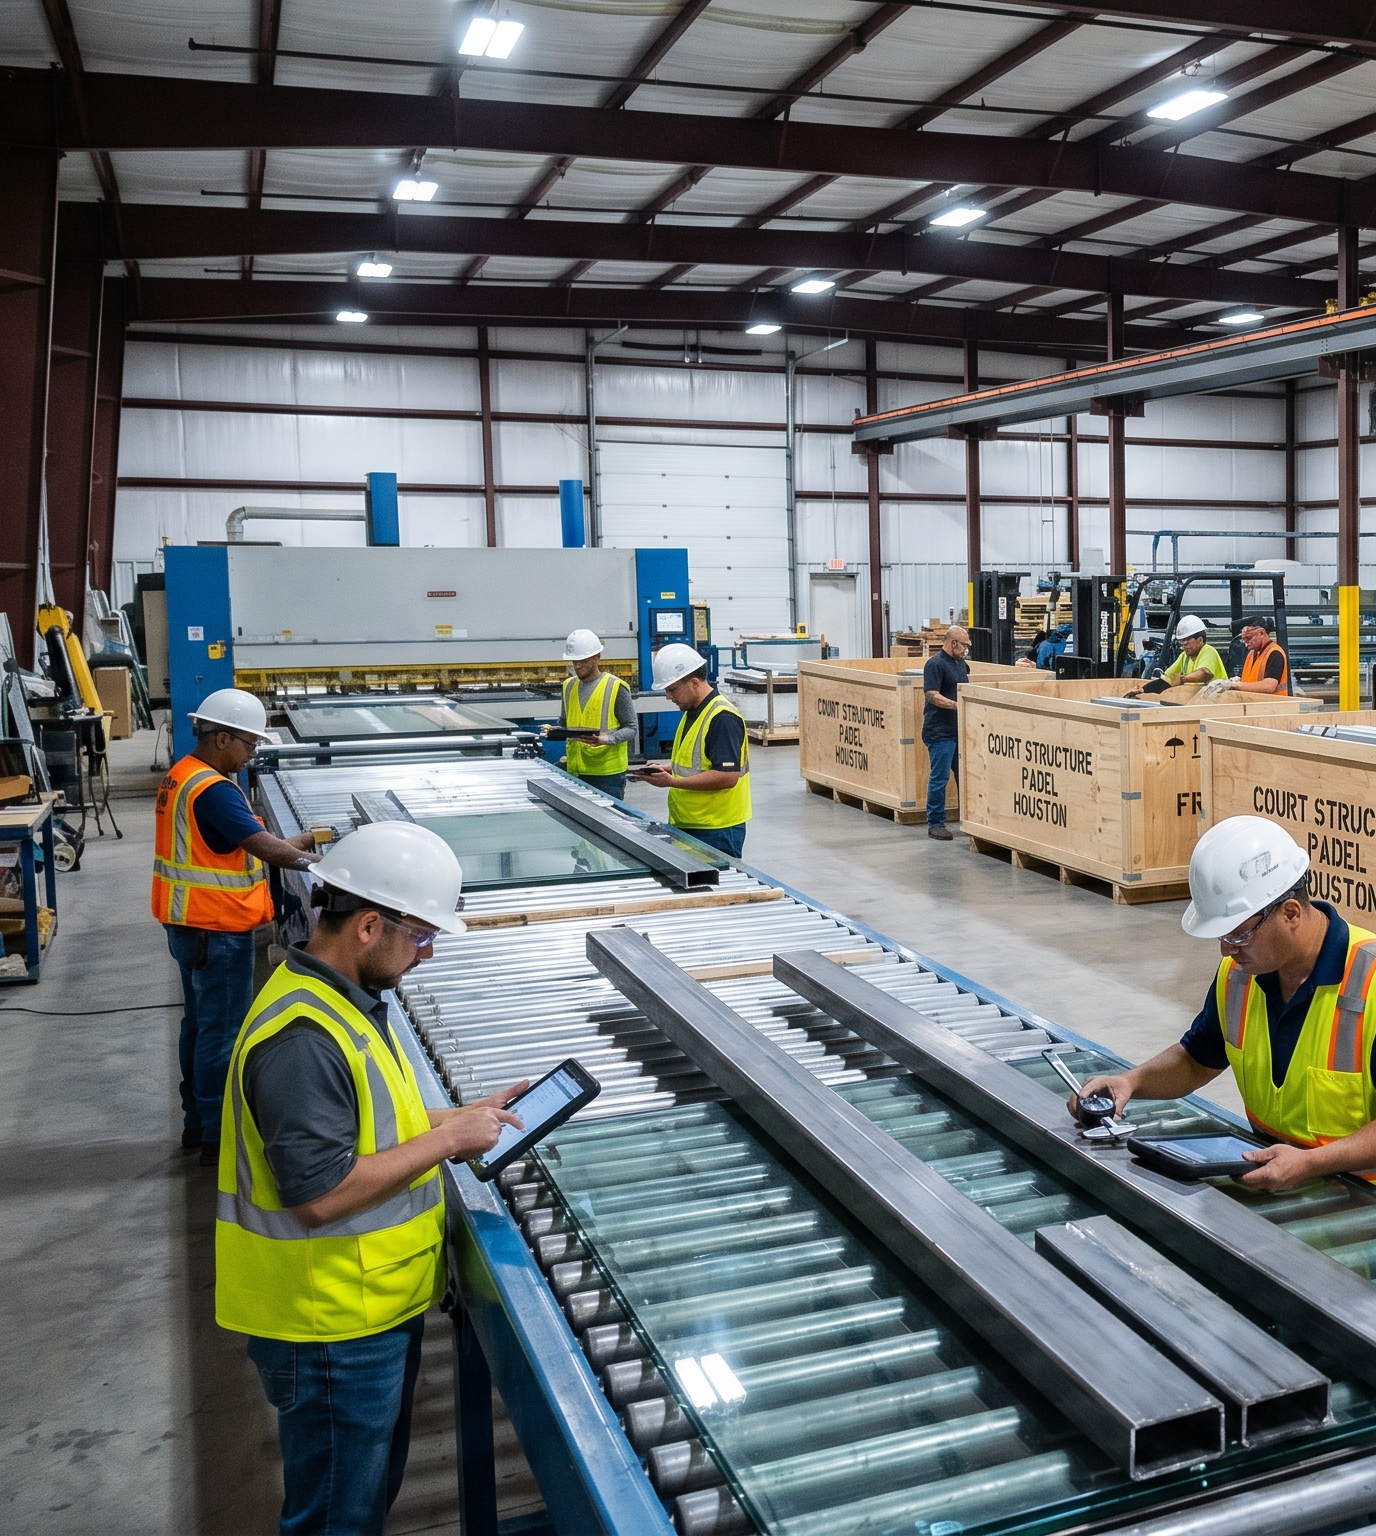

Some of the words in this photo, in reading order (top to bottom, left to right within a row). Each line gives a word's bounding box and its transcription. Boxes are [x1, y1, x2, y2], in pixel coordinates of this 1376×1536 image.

[839, 723, 863, 748] PADEL
[835, 745, 869, 772] HOUSTON
[987, 732, 1022, 760] COURT
[1025, 740, 1093, 776] STRUCTURE
[1021, 766, 1058, 797] PADEL
[1013, 792, 1067, 828] HOUSTON
[1253, 785, 1308, 823] COURT
[1307, 832, 1367, 874] PADEL
